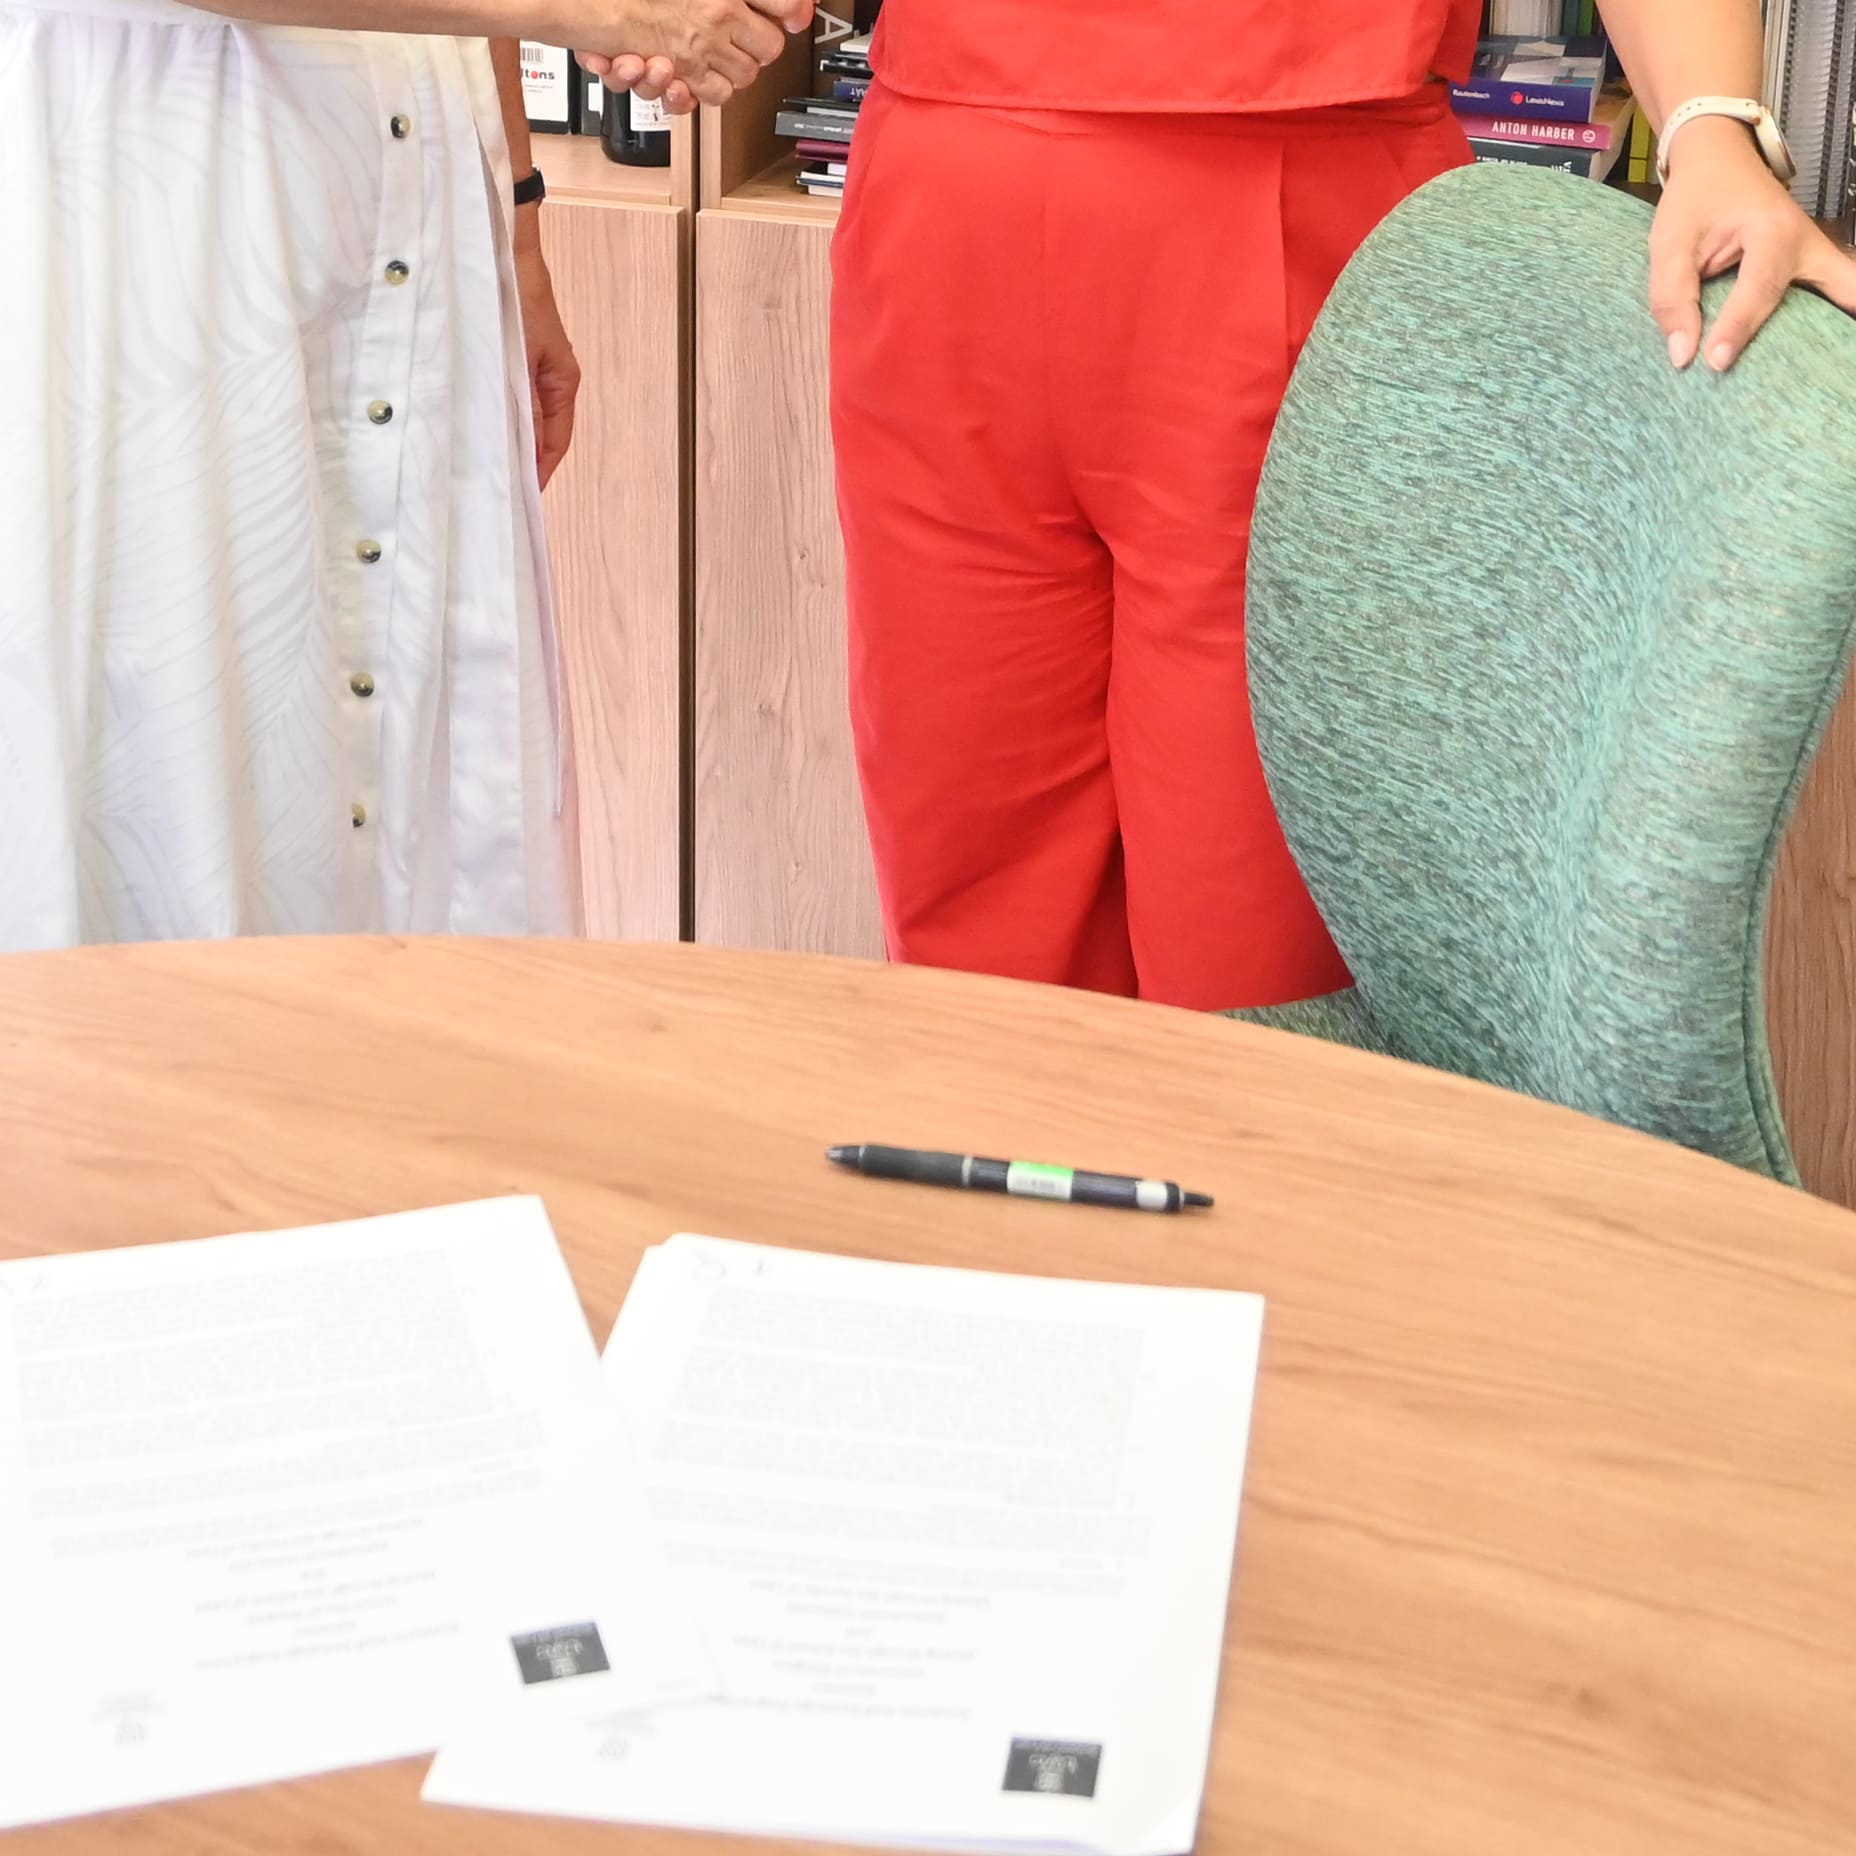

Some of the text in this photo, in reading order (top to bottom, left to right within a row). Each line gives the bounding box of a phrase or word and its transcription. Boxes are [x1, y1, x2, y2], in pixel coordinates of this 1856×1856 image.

[524, 69, 555, 80] tons
[1525, 94, 1565, 107] LexisNexis
[1492, 121, 1575, 140] ANTON HARBER
